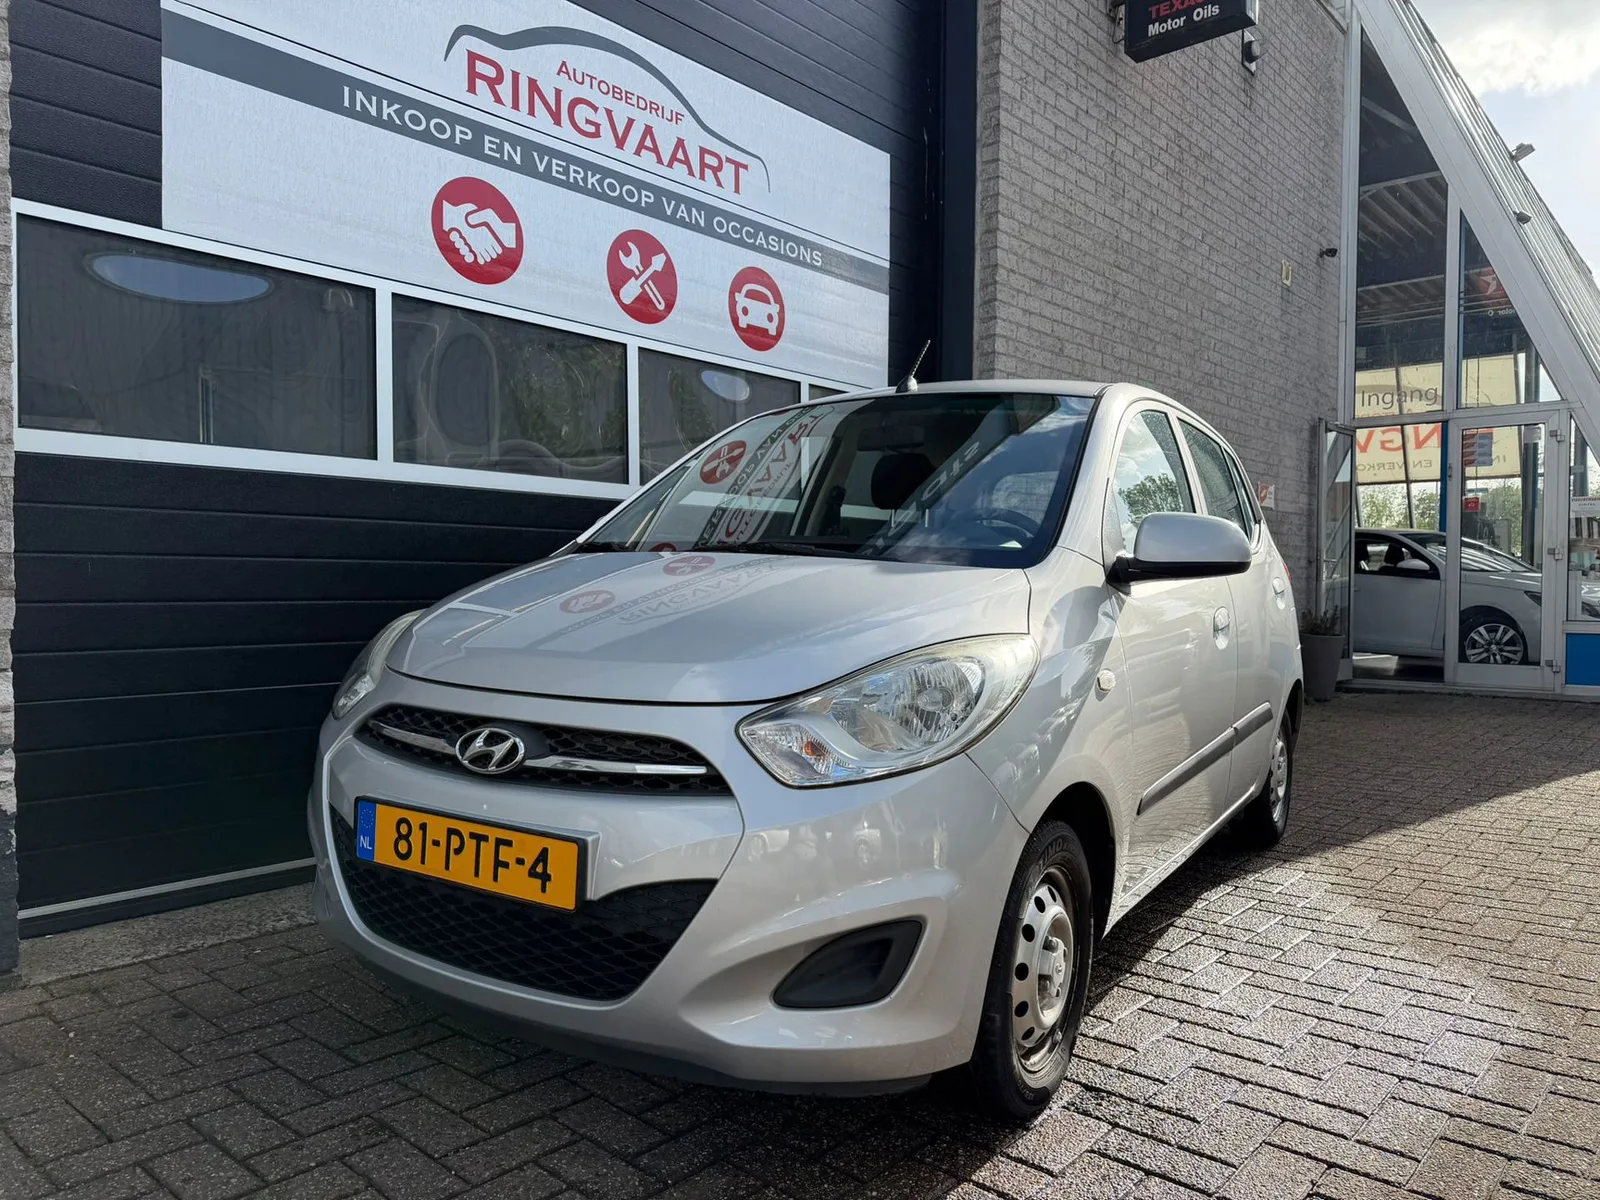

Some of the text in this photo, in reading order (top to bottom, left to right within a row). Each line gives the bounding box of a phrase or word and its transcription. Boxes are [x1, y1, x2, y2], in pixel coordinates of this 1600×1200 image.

[1148, 4, 1220, 37] Motor Oils
[466, 49, 749, 196] RINGVAART
[556, 60, 685, 126] AUTOBEDRIJF
[342, 85, 823, 266] INKOOP EN VERKOOP VAN OCCASIONS
[1361, 387, 1438, 410] Ingang
[359, 816, 552, 894] NL 81-PTF-4
